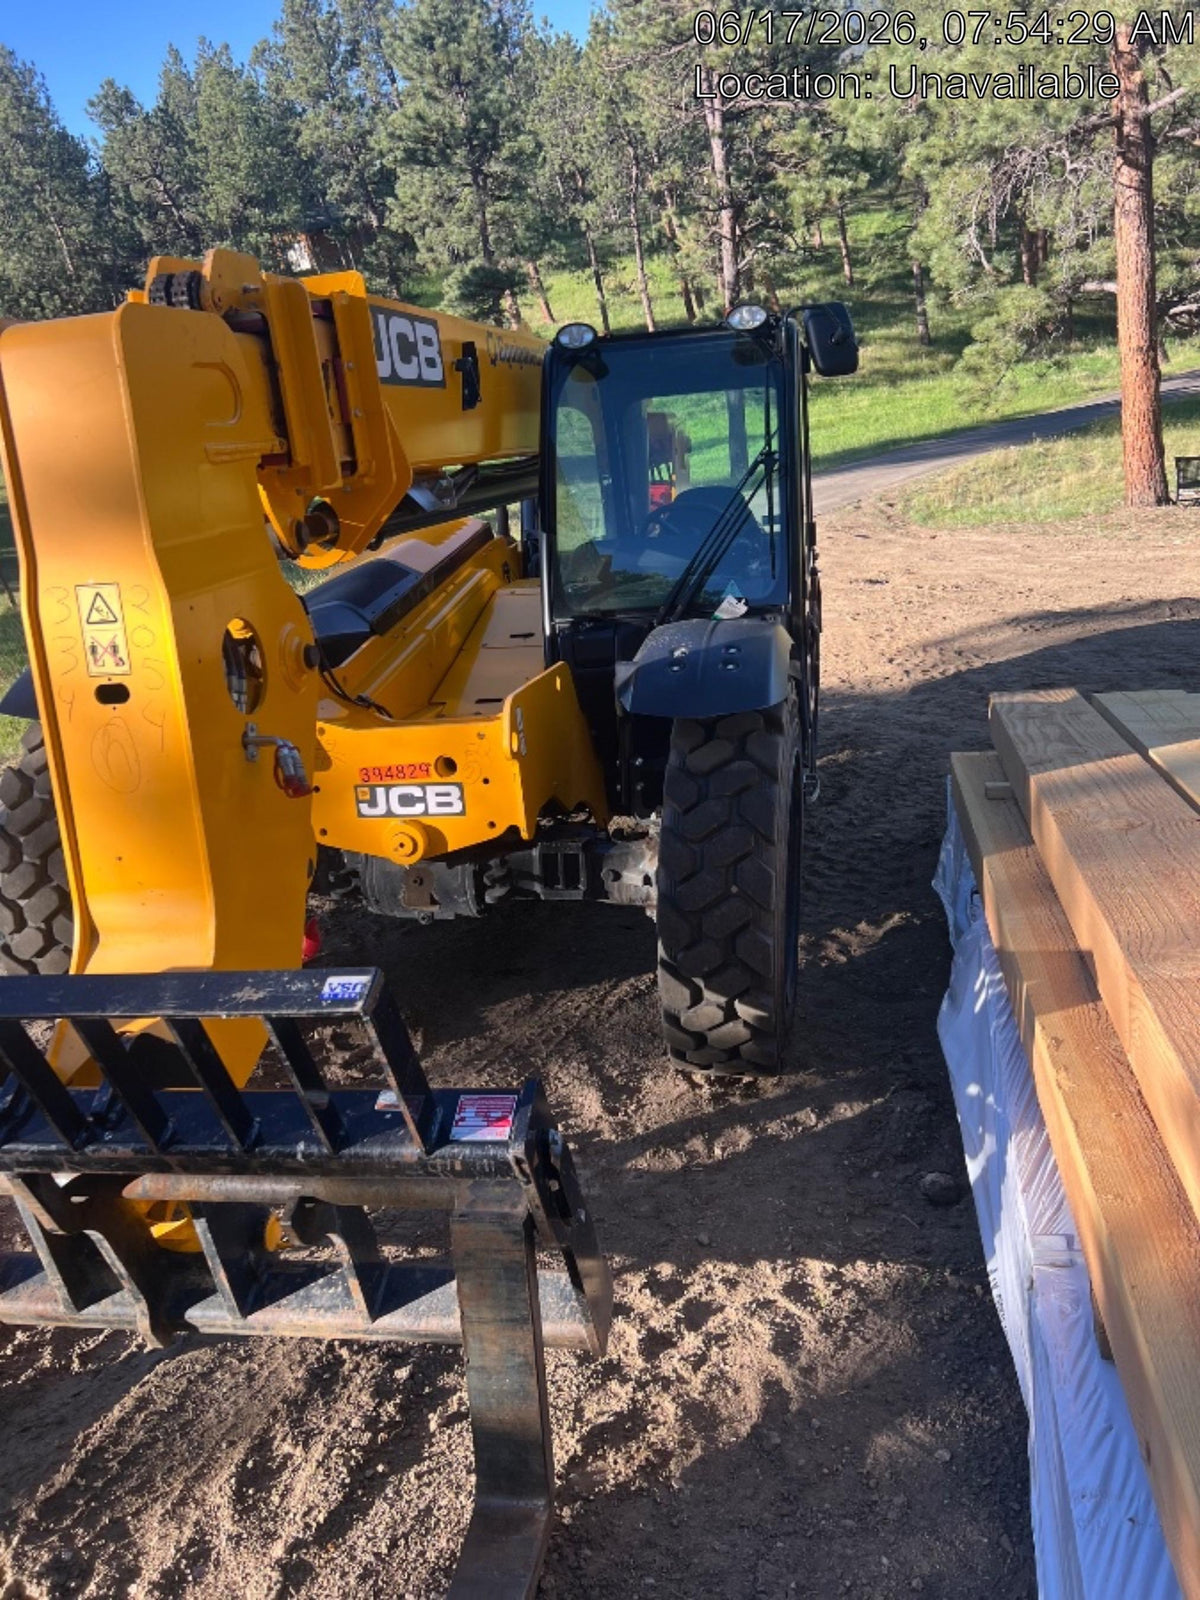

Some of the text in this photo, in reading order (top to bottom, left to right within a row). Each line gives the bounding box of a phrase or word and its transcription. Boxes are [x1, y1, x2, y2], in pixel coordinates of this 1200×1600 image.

[375, 314, 443, 381] JCB
[360, 763, 432, 782] 394829
[357, 785, 463, 816] JCB
